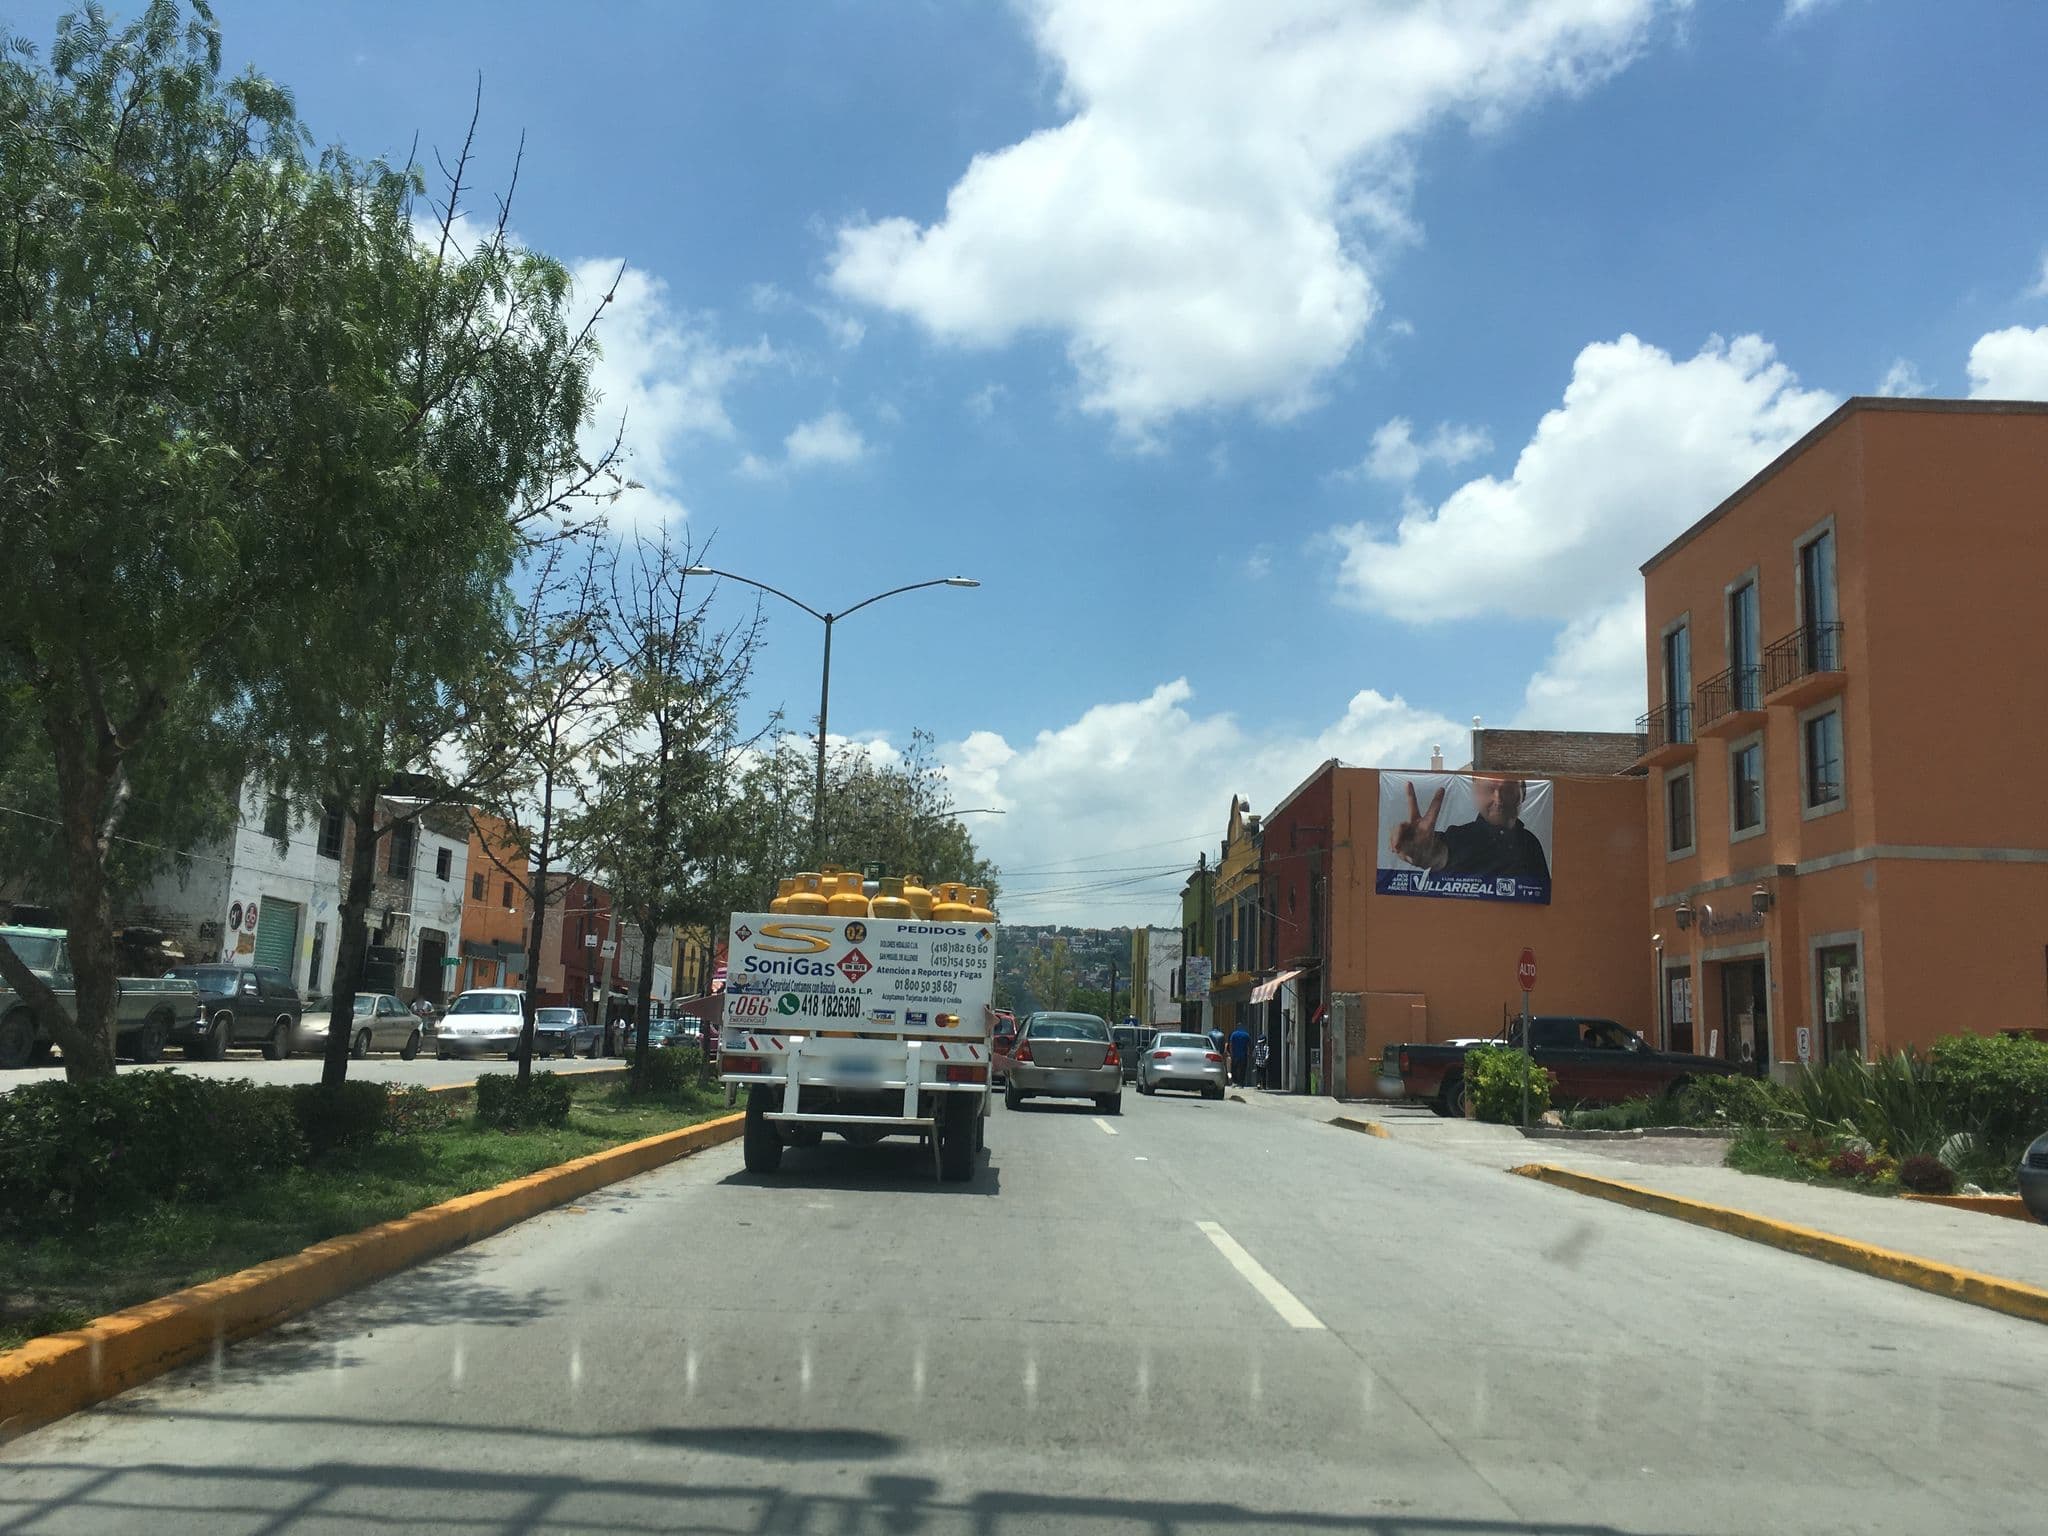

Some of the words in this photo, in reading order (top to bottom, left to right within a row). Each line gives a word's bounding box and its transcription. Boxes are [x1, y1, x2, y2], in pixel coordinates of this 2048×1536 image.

[1413, 868, 1494, 894] VILLARREAL
[897, 925, 967, 936] PEDIDOS
[966, 944, 976, 954] 63
[977, 944, 988, 953] 60
[744, 956, 835, 977] SoniGas
[966, 958, 975, 968] 50
[977, 959, 987, 968] 55
[1520, 963, 1536, 977] ALTO
[877, 966, 910, 975] Atención
[917, 968, 952, 977] Reportes
[953, 971, 959, 979] y
[960, 970, 982, 980] Fugas
[859, 987, 873, 995] L.P.
[895, 980, 903, 990] 01
[904, 978, 919, 991] 800
[920, 982, 930, 993] 50
[932, 981, 941, 994] 38
[942, 980, 957, 994] 687
[735, 995, 770, 1016] 066
[801, 994, 819, 1016] 418
[821, 995, 861, 1018] 1826360
